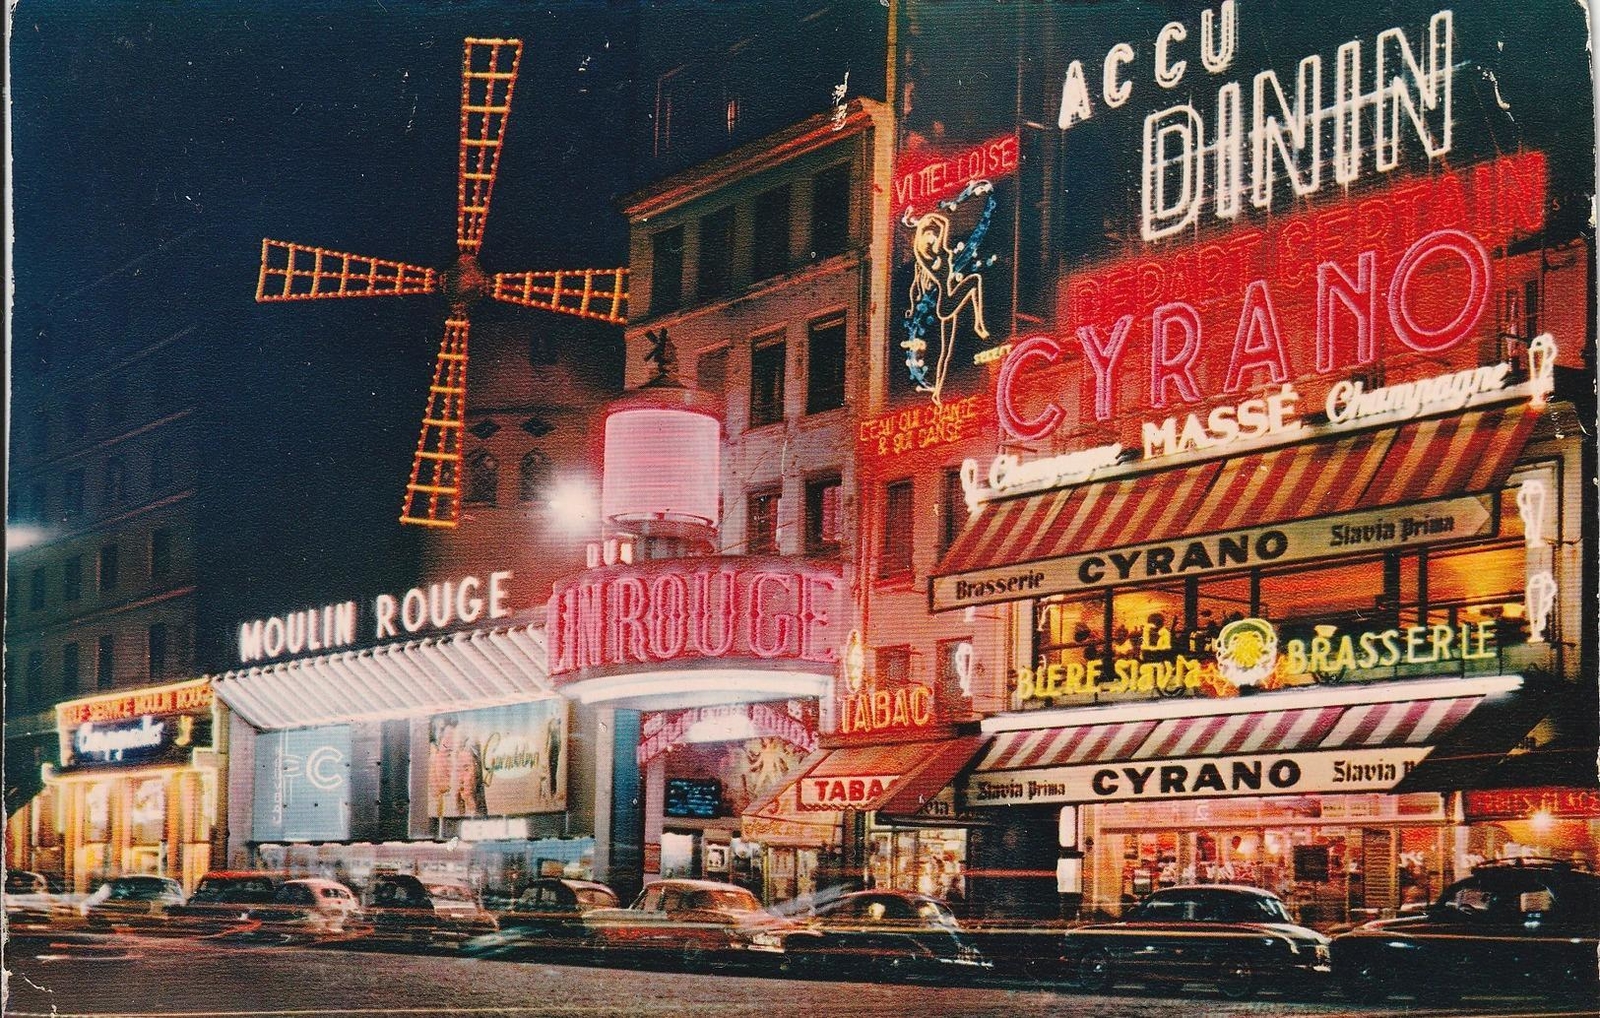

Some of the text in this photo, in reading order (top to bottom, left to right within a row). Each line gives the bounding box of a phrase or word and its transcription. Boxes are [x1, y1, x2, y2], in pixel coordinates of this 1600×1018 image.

[1057, 0, 1239, 131] ACCU
[1141, 9, 1454, 242] DININ
[997, 227, 1492, 441] CYRANO
[1142, 383, 1299, 460] MASSÉ
[1326, 361, 1512, 424] Champagne
[955, 513, 1455, 600] Brasserie CYRANO Slavia Prima
[239, 570, 513, 663] MOULIN ROUGE
[606, 569, 841, 664] ROUGE
[1288, 621, 1498, 675] BRASSERIE
[841, 686, 932, 733] TABAC
[1028, 779, 1067, 801] Prima
[1092, 758, 1303, 798] CYRANO
[1332, 757, 1397, 783] Slavia
